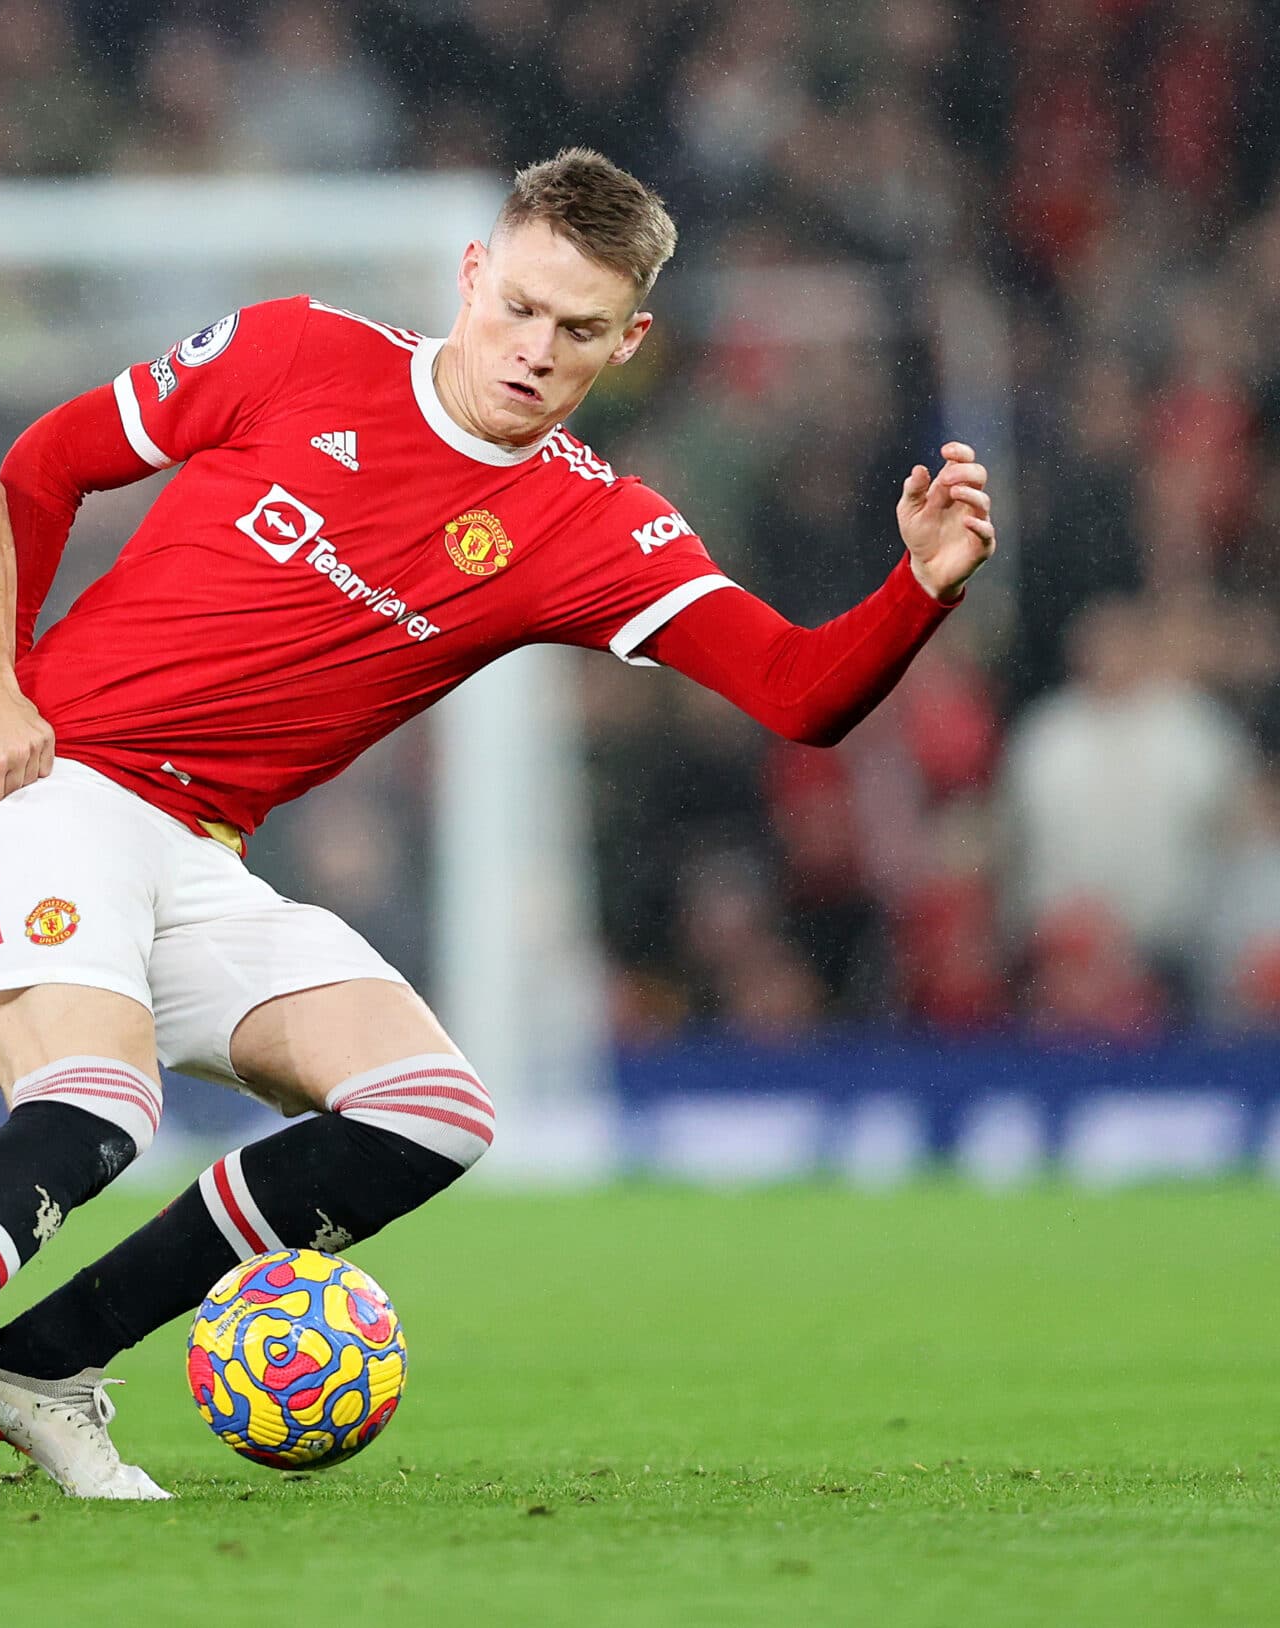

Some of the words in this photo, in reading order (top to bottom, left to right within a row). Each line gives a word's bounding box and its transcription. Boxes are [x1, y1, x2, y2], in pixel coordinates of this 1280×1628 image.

[310, 435, 360, 472] adidas
[458, 511, 508, 551] MANCHESTER
[631, 512, 697, 555] KOH
[450, 546, 486, 573] UNITED
